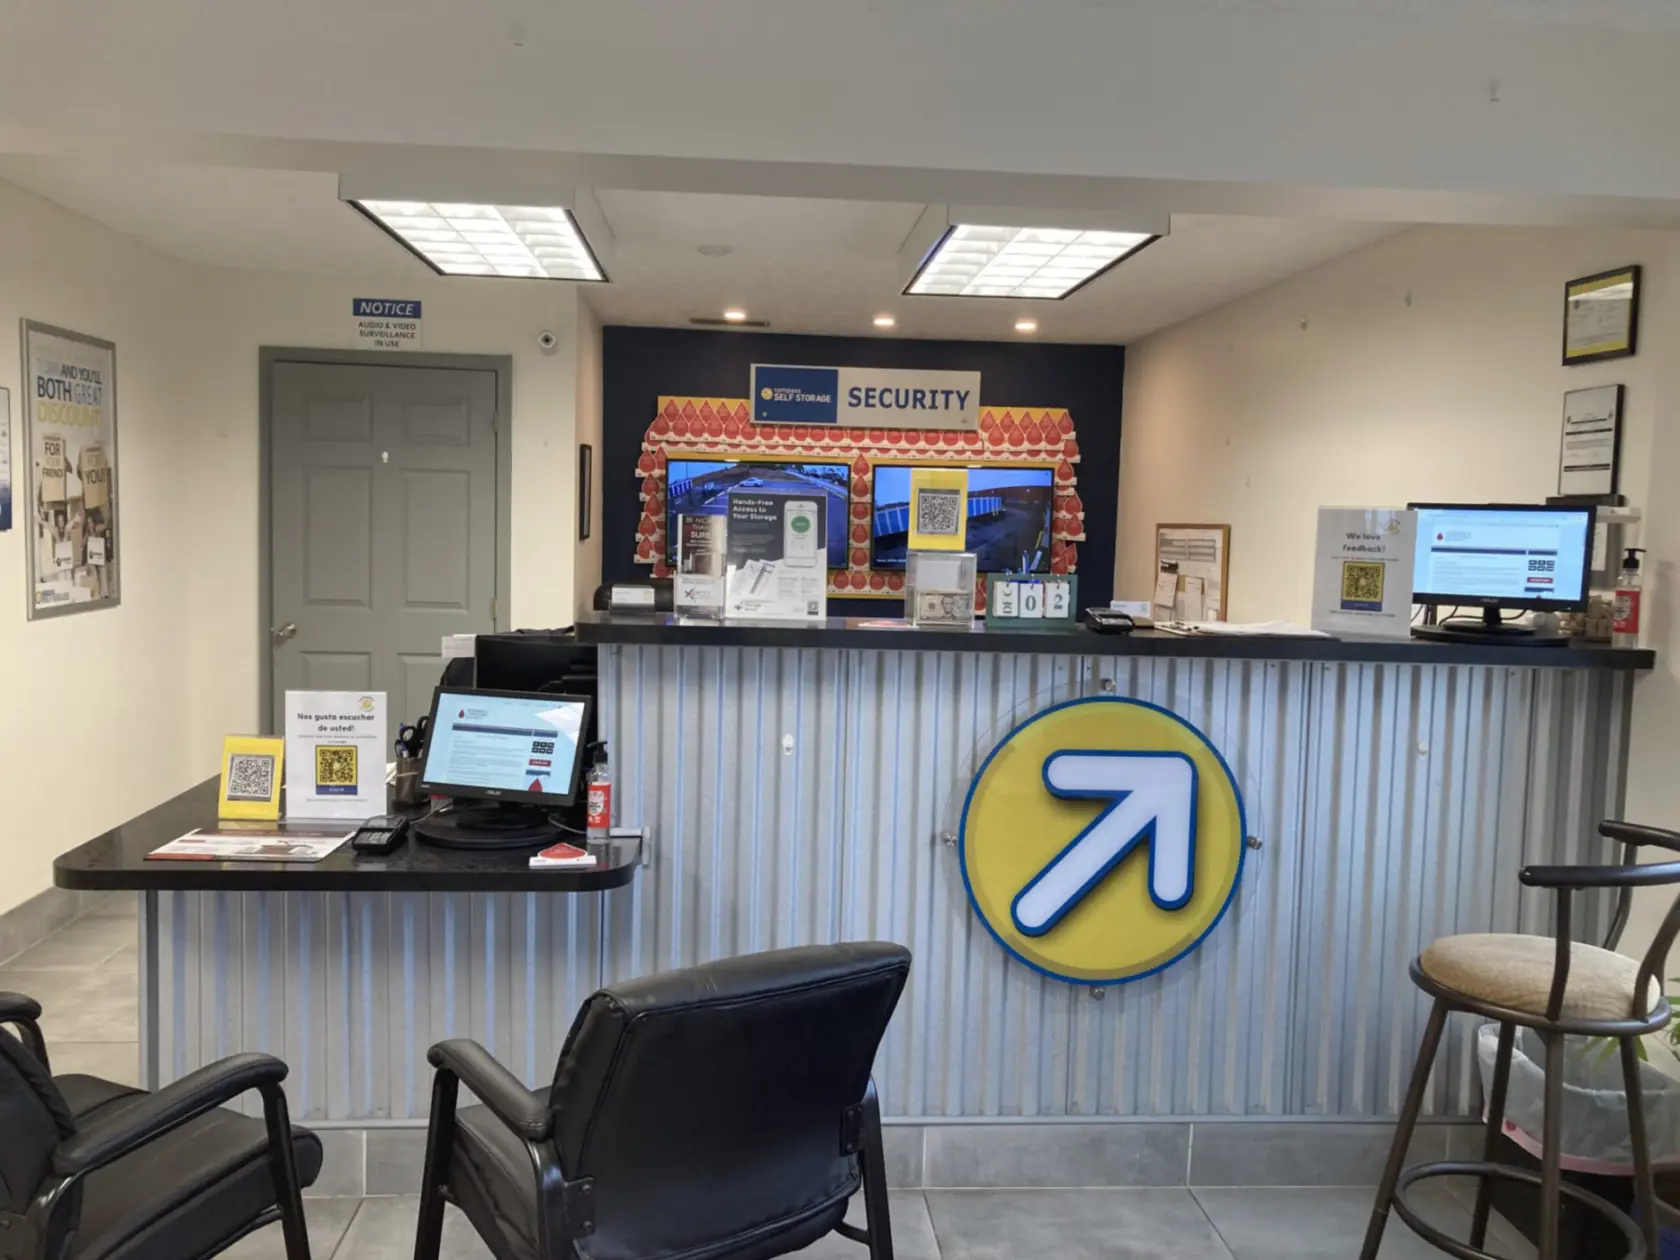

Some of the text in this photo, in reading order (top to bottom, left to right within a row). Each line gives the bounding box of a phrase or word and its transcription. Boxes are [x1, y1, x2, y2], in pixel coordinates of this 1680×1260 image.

[360, 301, 415, 316] NOTICE
[358, 321, 384, 329] AUDIO
[359, 330, 416, 339] SURVEILLANCE
[61, 363, 77, 380] AND
[37, 375, 72, 402] BOTH
[774, 393, 832, 403] SELF STORAGE
[848, 386, 970, 410] SECURITY
[45, 441, 60, 456] FOR
[732, 498, 774, 506] Hands-Free
[750, 513, 778, 522] Storage
[1025, 595, 1037, 611] 0
[1053, 594, 1064, 610] 2
[314, 713, 337, 722] gusta
[339, 713, 375, 721] escuchar
[317, 724, 328, 732] de
